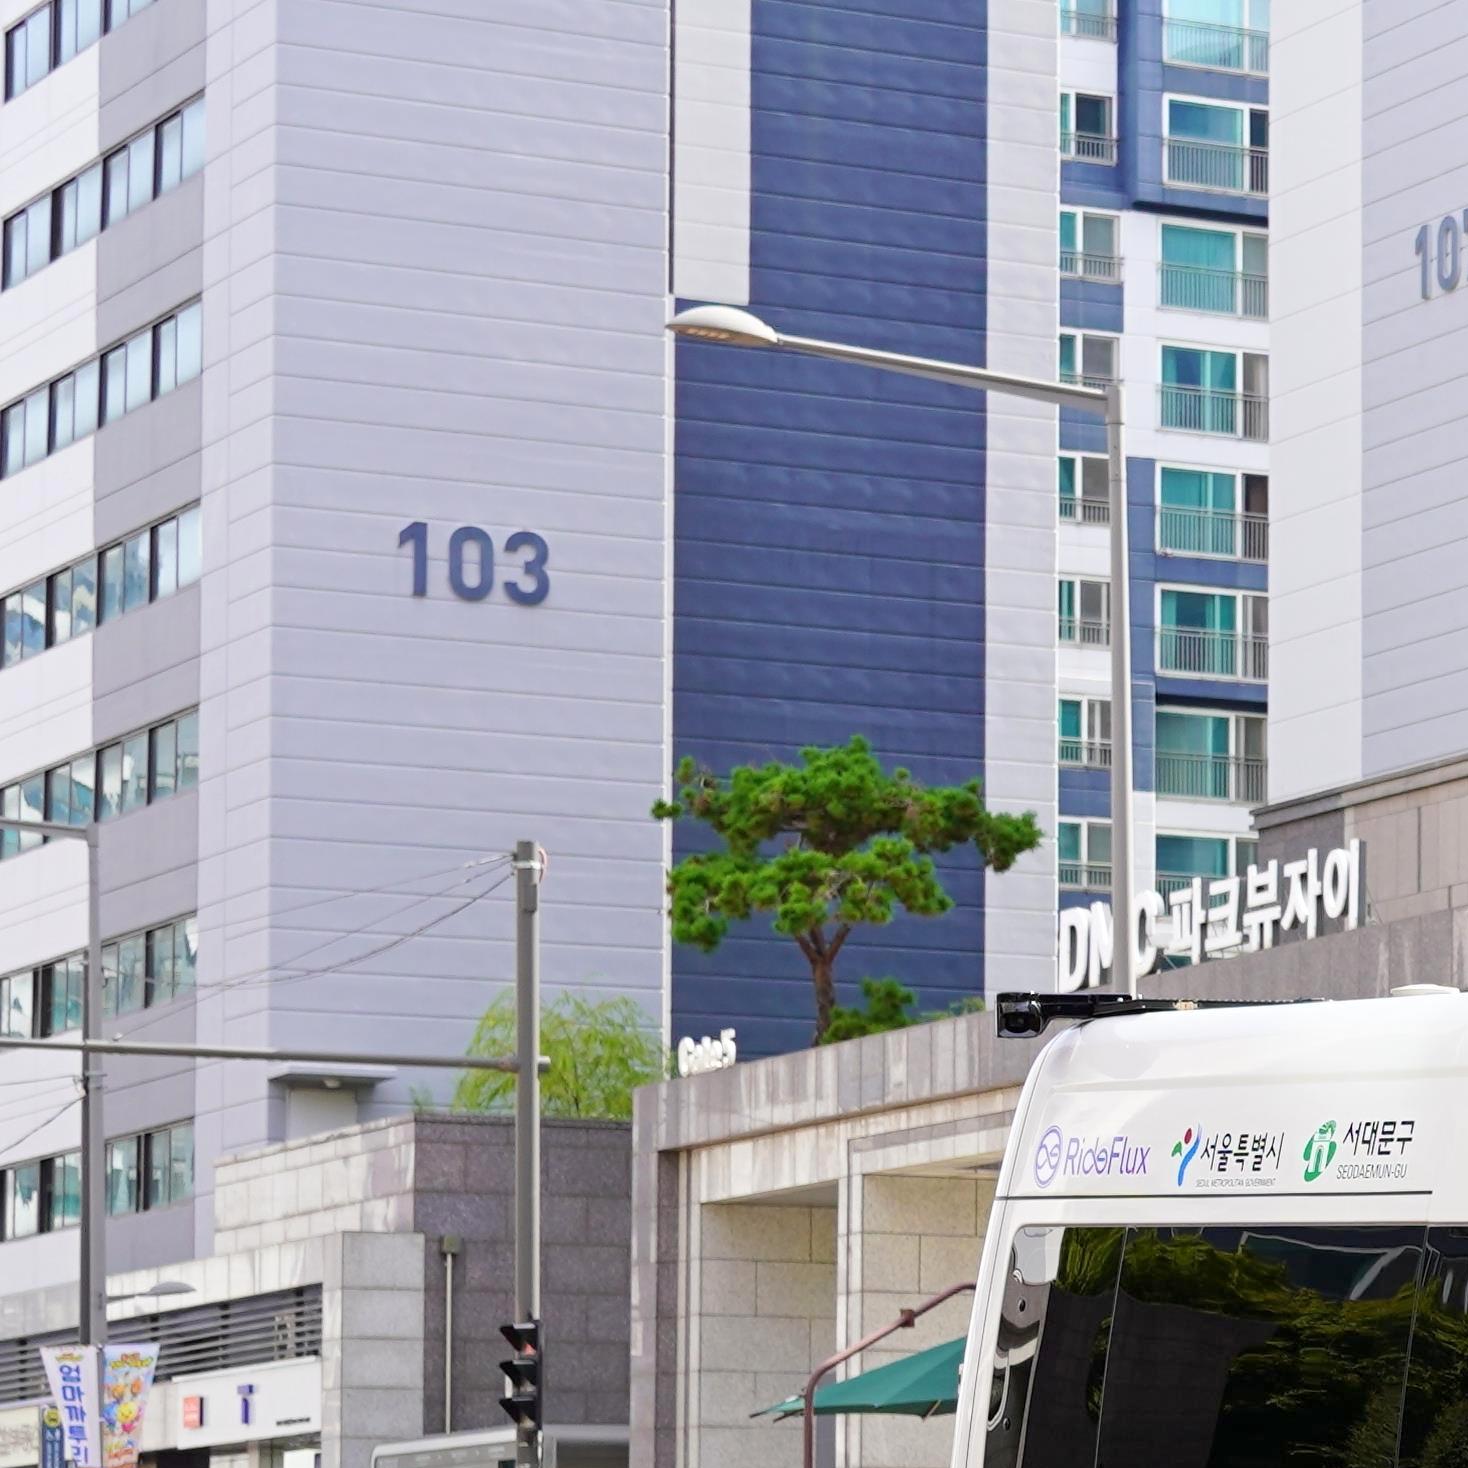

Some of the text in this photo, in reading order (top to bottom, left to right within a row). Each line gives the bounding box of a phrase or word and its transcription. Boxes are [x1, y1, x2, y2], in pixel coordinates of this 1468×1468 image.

[398, 521, 550, 607] 103
[1063, 1135, 1151, 1175] RideFlux
[1200, 1132, 1285, 1172] 서울특별시
[1342, 1120, 1416, 1157] 서대문구
[1336, 1164, 1408, 1180] SEODAEMUN-GU
